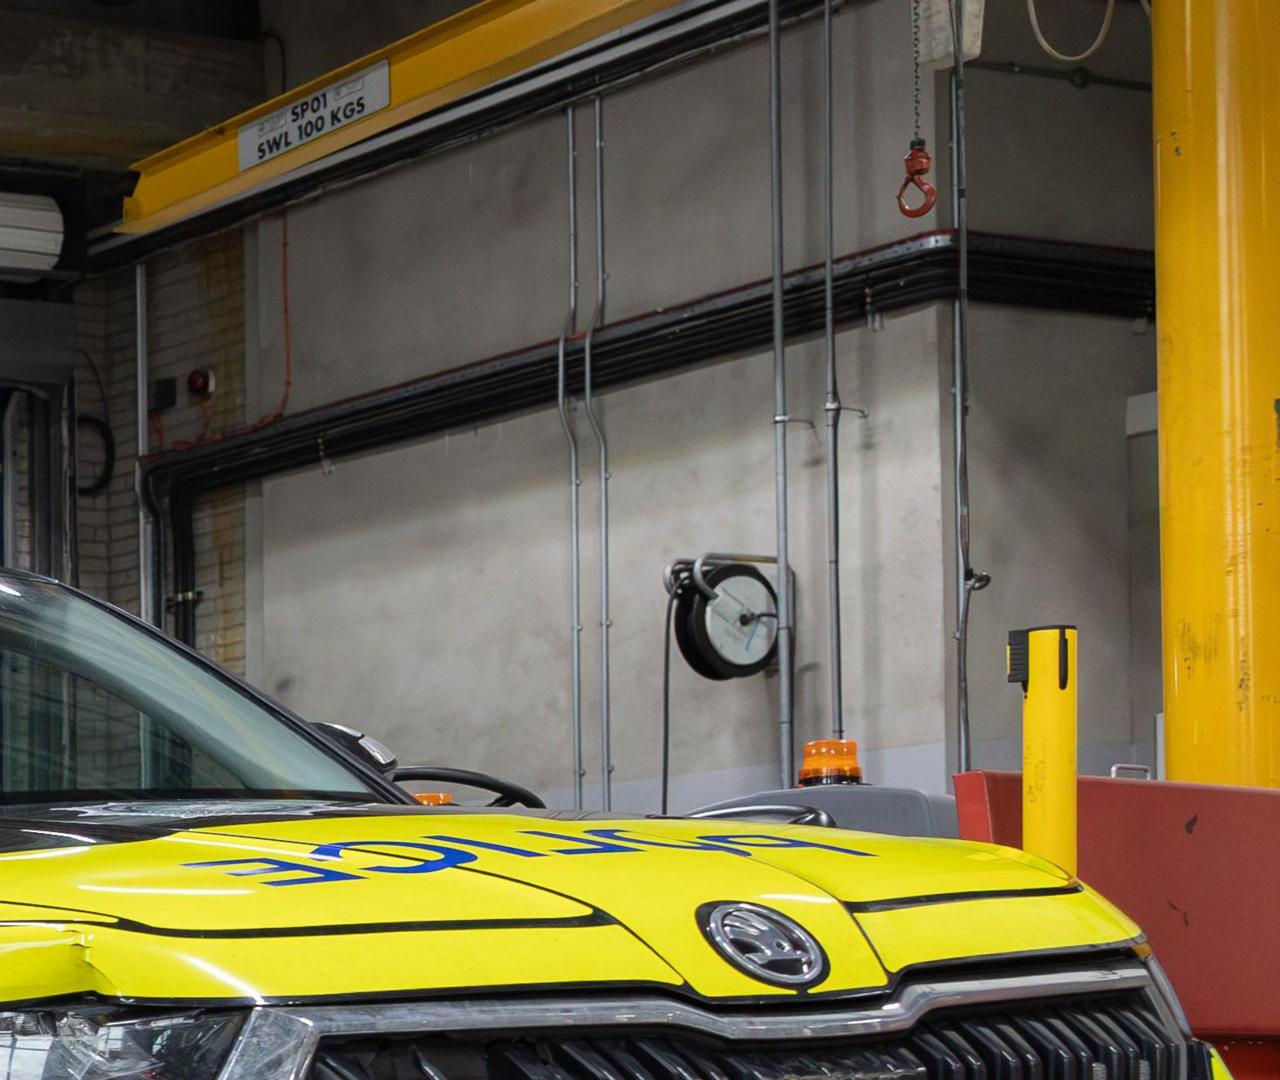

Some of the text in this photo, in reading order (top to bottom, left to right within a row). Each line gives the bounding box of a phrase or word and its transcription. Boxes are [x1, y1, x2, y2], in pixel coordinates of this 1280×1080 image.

[257, 131, 292, 160] SWL
[297, 116, 326, 140] 100
[330, 96, 366, 126] KGS
